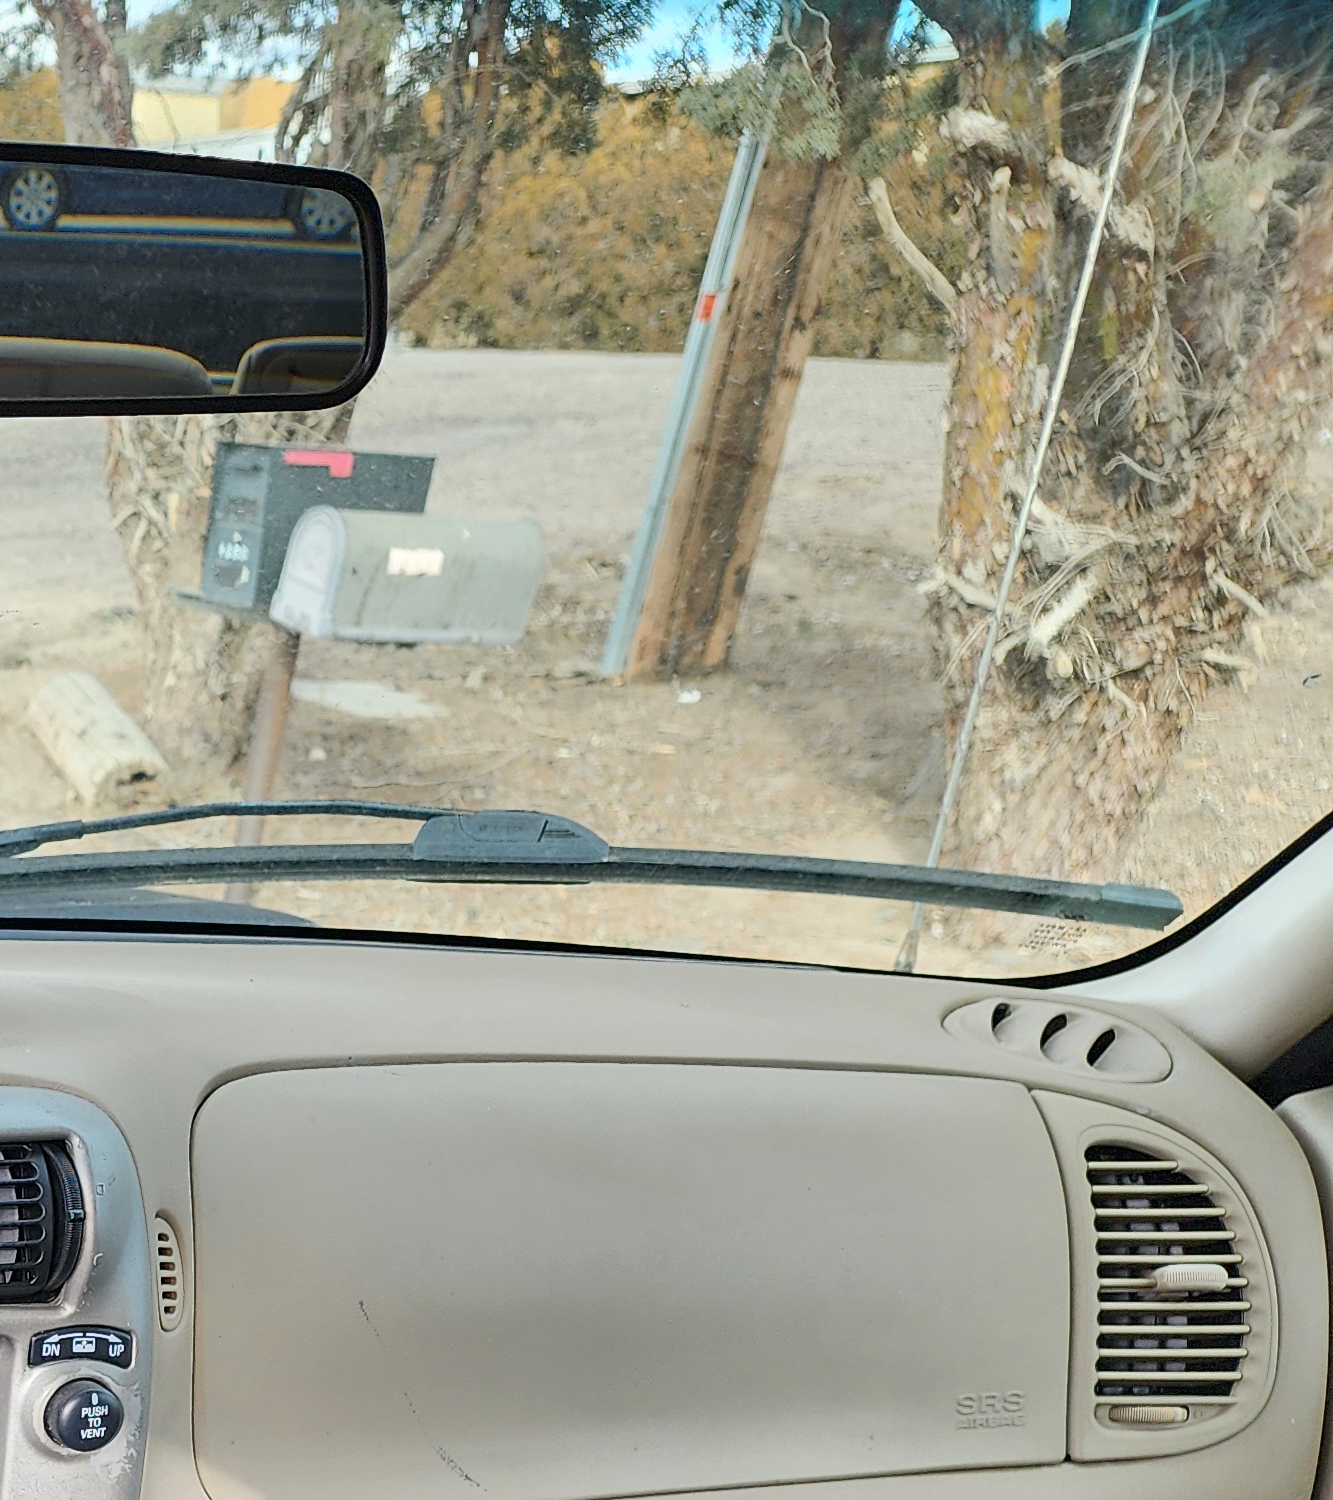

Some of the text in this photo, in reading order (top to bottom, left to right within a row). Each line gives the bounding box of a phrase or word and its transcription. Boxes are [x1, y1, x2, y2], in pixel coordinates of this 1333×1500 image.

[42, 1344, 60, 1356] DN
[109, 1345, 124, 1357] UP
[955, 1391, 1025, 1415] SRS
[81, 1405, 108, 1418] PUSH
[88, 1418, 101, 1427] TO
[80, 1427, 106, 1439] VENT
